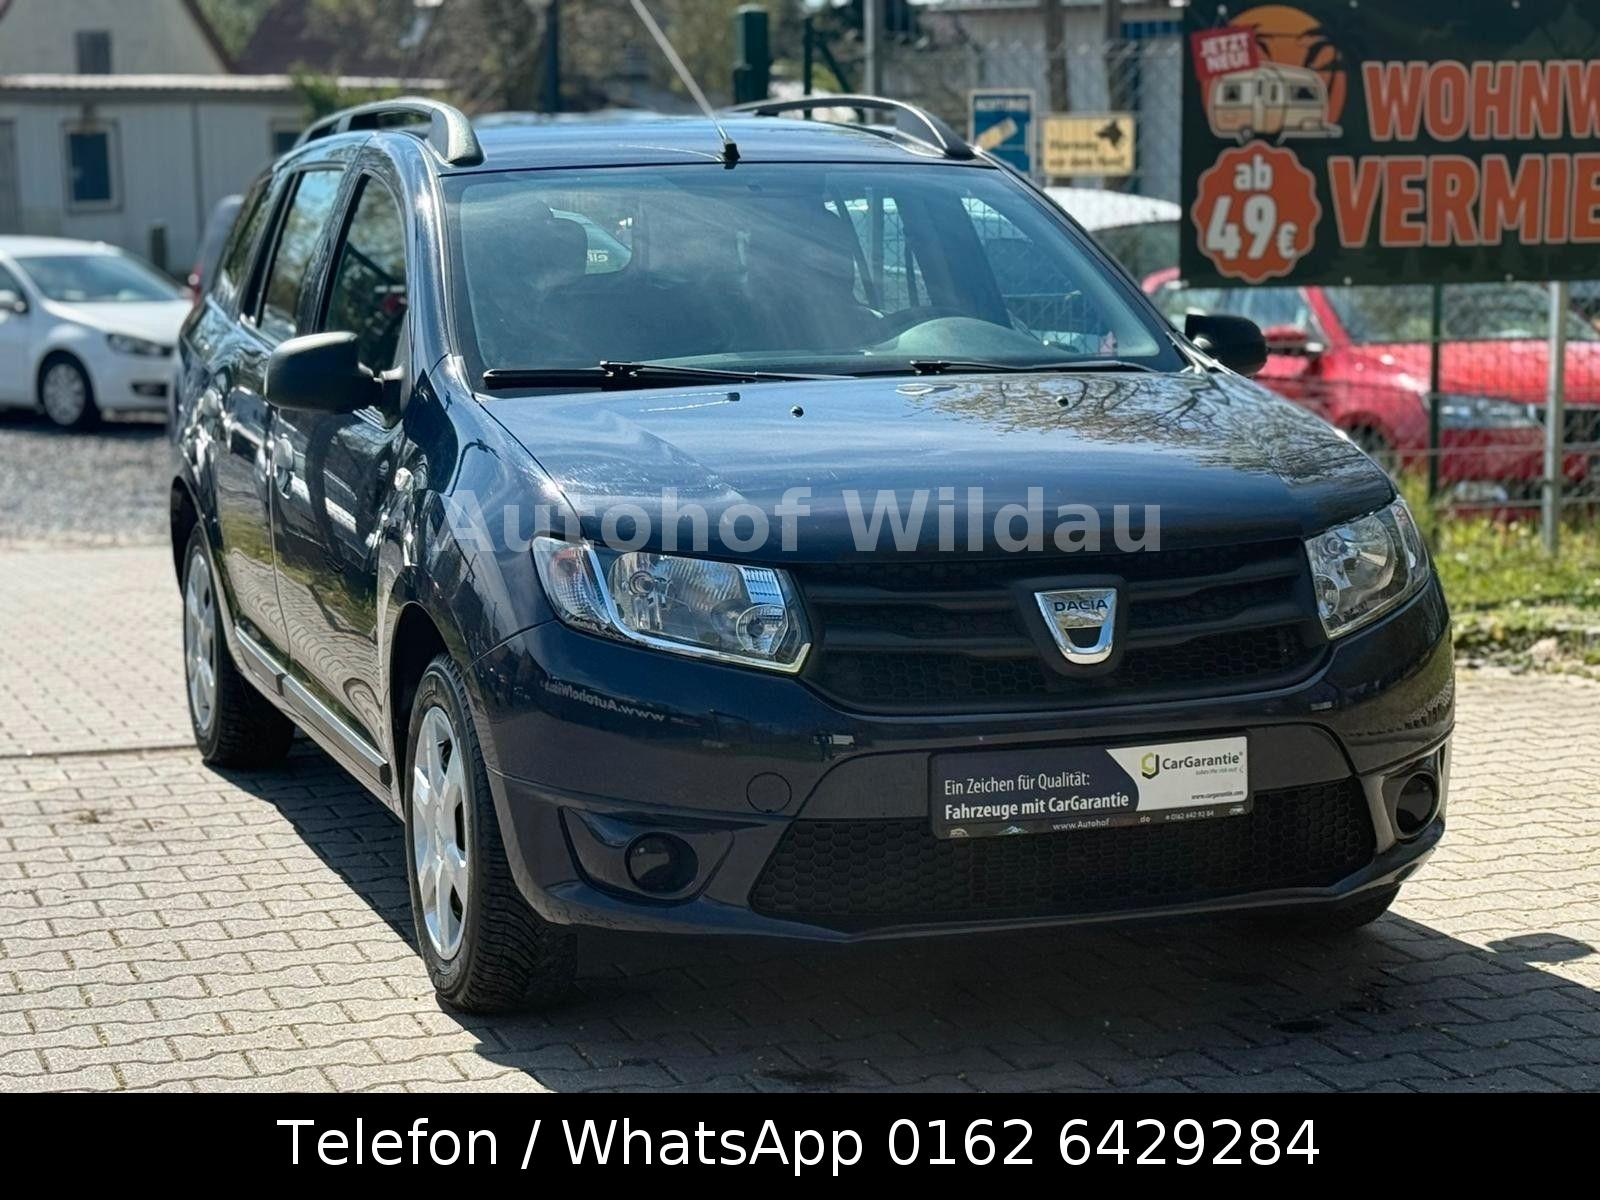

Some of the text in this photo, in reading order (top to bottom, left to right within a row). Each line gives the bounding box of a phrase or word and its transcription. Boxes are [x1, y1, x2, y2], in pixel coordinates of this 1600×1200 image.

[1200, 32, 1250, 58] JETZT
[1233, 154, 1273, 192] ab
[1205, 193, 1298, 261] 49€
[1053, 599, 1109, 612] DACIA
[1162, 752, 1240, 770] CarGarantie
[944, 770, 1091, 796] Ein Zeichen für Qualität:
[944, 792, 1129, 820] Fahrzeuge mit CarGarantie
